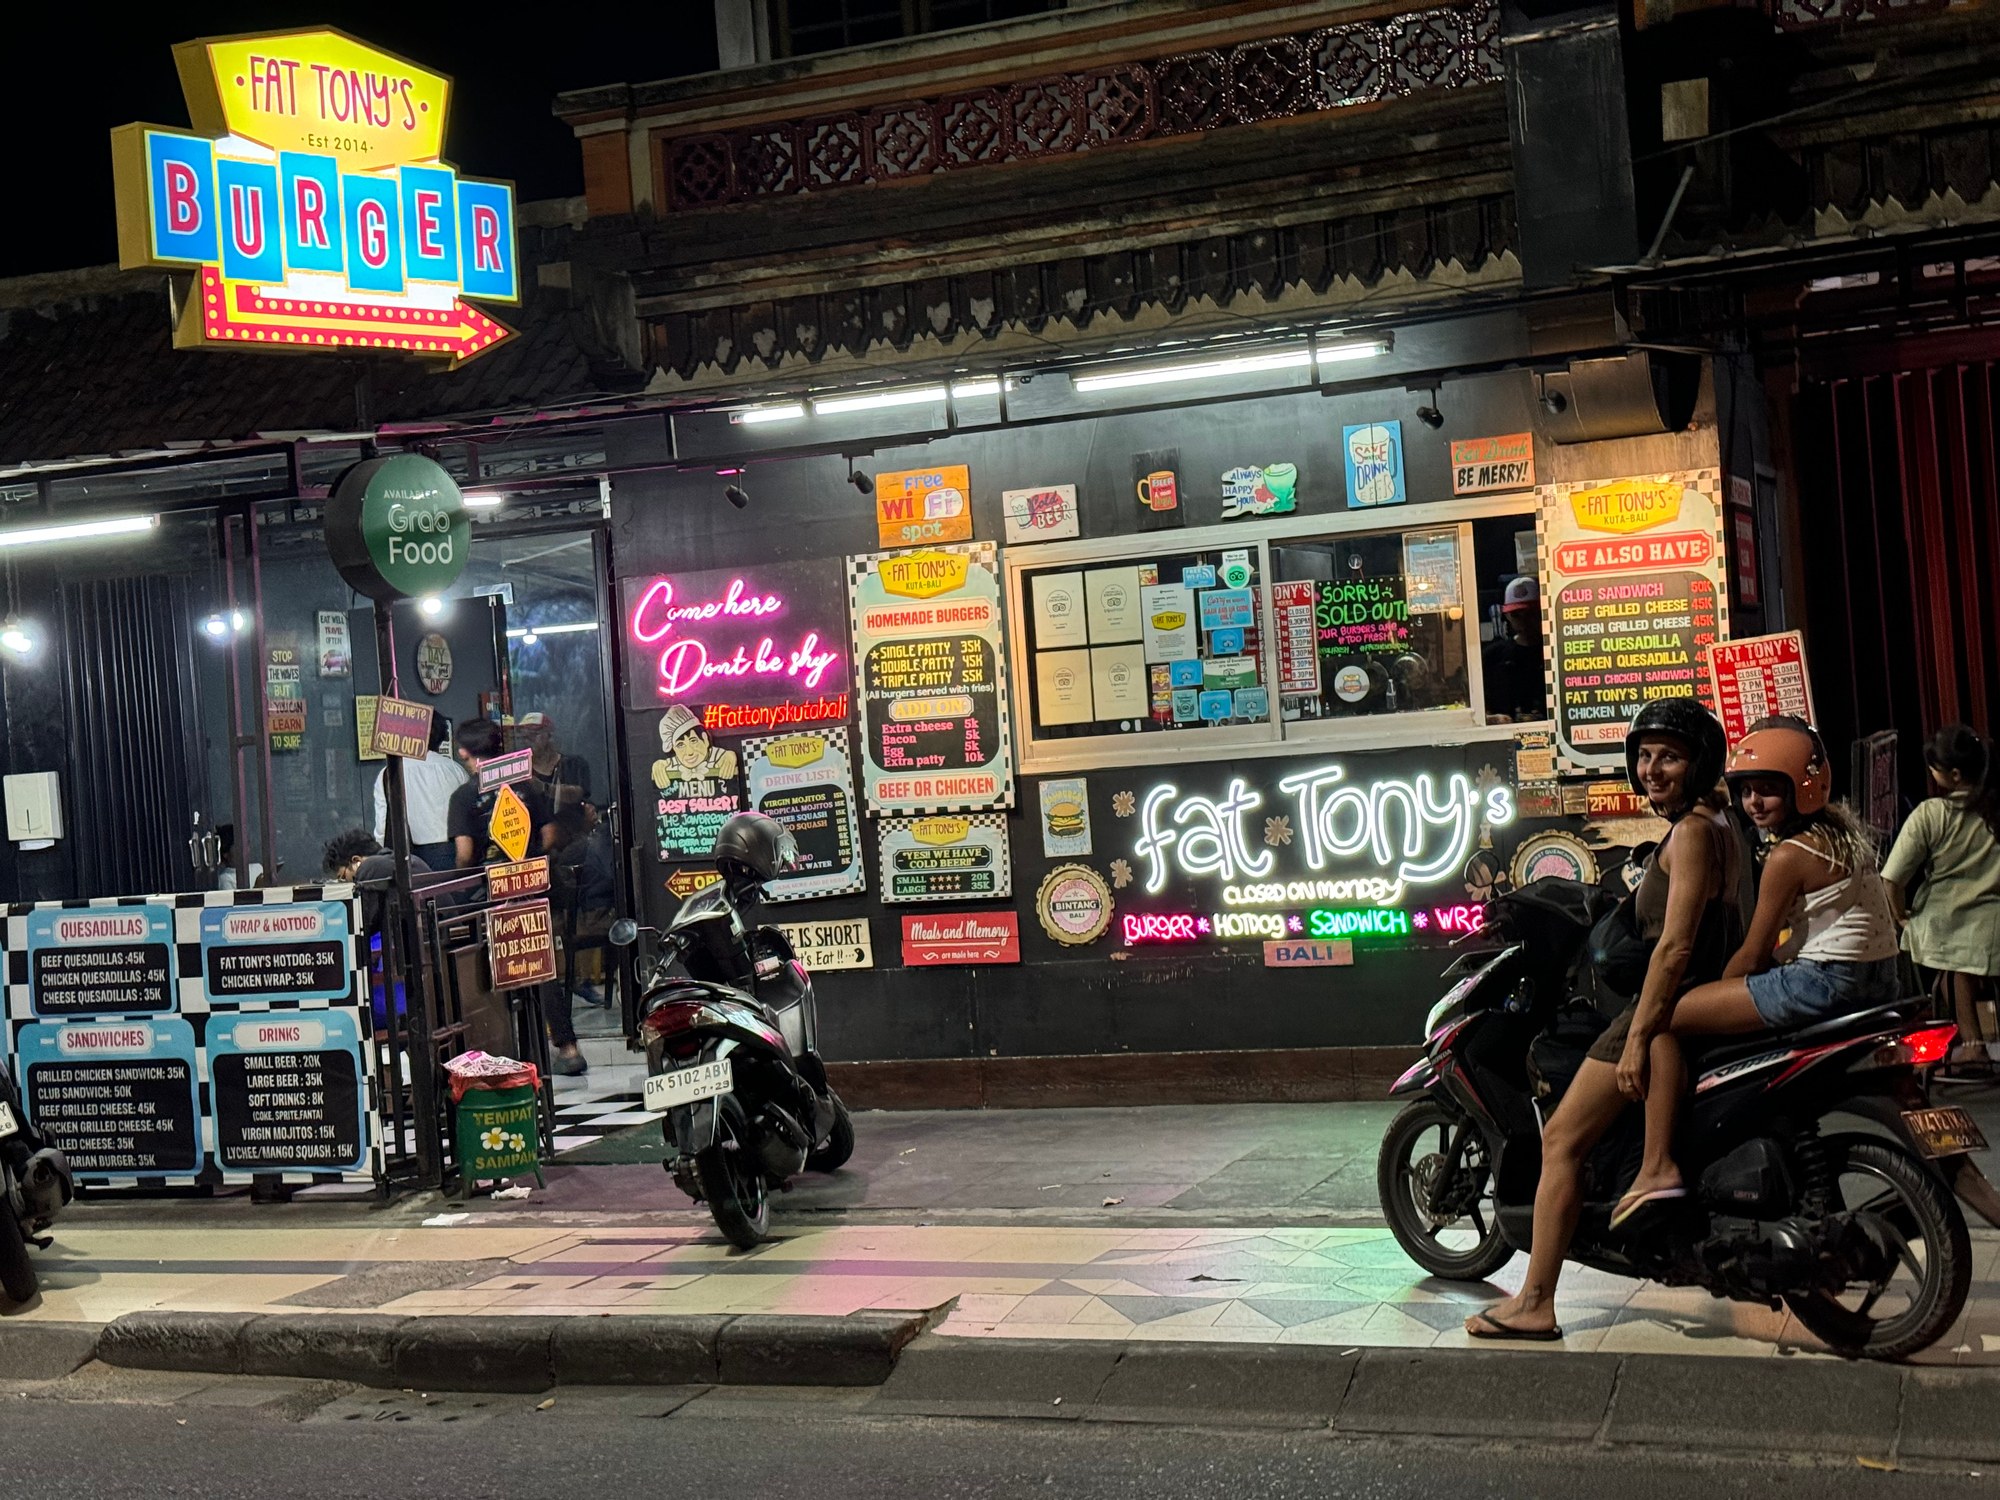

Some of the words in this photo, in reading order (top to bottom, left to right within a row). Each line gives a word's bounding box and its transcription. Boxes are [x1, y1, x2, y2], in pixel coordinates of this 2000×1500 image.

[250, 56, 300, 115] FAT
[310, 64, 416, 130] TONY'S
[308, 133, 328, 148] Est
[334, 137, 368, 153] 2014
[163, 159, 504, 273] BURGER
[1354, 443, 1387, 464] SAVE
[904, 474, 943, 490] Free
[1152, 478, 1173, 486] BEER
[1356, 462, 1388, 490] DRINK
[1457, 467, 1474, 488] BE
[1478, 461, 1528, 487] MERRY!
[1225, 485, 1254, 494] HAPPY
[1588, 495, 1611, 515] FAT
[1615, 490, 1667, 512] TONY'S
[388, 504, 450, 533] Grab
[1036, 502, 1073, 529] BEER
[1603, 514, 1649, 525] KUTA-BALI
[901, 520, 944, 541] spot
[388, 535, 453, 565] Food
[1561, 550, 1587, 568] WE
[1594, 545, 1643, 566] ALSO
[1649, 539, 1708, 561] HAVE:
[892, 564, 911, 581] FAT
[914, 560, 956, 580] TONY'S
[906, 580, 941, 590] KUTA-BALI
[1322, 584, 1380, 604] SORRY
[1562, 588, 1593, 603] CLUB
[1598, 583, 1664, 600] SANDWICH
[1691, 580, 1712, 593] 50K
[634, 581, 723, 642] Come
[723, 579, 781, 615] here
[867, 610, 933, 629] HOMEMADE
[936, 605, 989, 623] BURGERS
[1316, 603, 1367, 628] SOLD
[1372, 600, 1408, 621] OUT!
[273, 650, 293, 662] STOP
[880, 645, 916, 659] SINGLE
[918, 642, 951, 656] PATTY
[961, 640, 981, 653] 35K
[1716, 645, 1744, 664] FAT
[1744, 637, 1798, 660] TONY'S
[659, 640, 751, 696] Dont
[755, 637, 783, 673] be
[788, 633, 837, 688] shy
[1738, 670, 1762, 679] CLOSED
[1773, 664, 1798, 674] CLOSED
[269, 668, 281, 680] THE
[280, 668, 299, 680] WAVES
[275, 685, 290, 696] BUT
[865, 691, 880, 701] (All
[881, 689, 915, 701] burgers
[917, 686, 947, 696] served
[949, 684, 969, 694] with
[971, 682, 994, 693] fries)
[273, 719, 302, 730] LEARN
[882, 723, 912, 734] Extra
[914, 721, 953, 732] cheese
[964, 718, 979, 729] 5k
[272, 736, 282, 748] TO
[284, 735, 302, 748] SURF
[774, 743, 787, 758] FAT
[788, 741, 818, 755] TONY'S
[765, 774, 803, 787] DRINK
[806, 770, 835, 782] LIST:
[678, 779, 716, 798] MENU
[879, 782, 910, 799] BEEF
[914, 780, 932, 796] OR
[936, 777, 994, 795] CHICKEN
[764, 798, 790, 808] VIRGIN
[792, 794, 826, 804] MOJITOS
[502, 807, 517, 817] LEADS
[501, 832, 510, 841] FAT
[919, 823, 934, 836] FAT
[935, 821, 960, 835] TONY'S
[1135, 779, 1273, 893] fat
[1279, 765, 1512, 883] Tony's
[491, 878, 508, 895] 2PM
[511, 876, 522, 890] TO
[896, 876, 927, 884] SMALL
[971, 873, 989, 881] 20K
[1056, 901, 1097, 911] BINTANG
[61, 918, 143, 942] QUESADILLAS
[230, 919, 260, 934] WRAP
[263, 922, 270, 932] &
[273, 916, 316, 932] HOTDOG
[494, 916, 519, 938] Please
[519, 911, 547, 933] WAIT
[911, 920, 941, 941] Meals
[943, 922, 963, 939] and
[965, 919, 1010, 946] Memory
[799, 927, 812, 948] IS
[816, 923, 862, 948] SHORT
[494, 942, 507, 960] TO
[508, 939, 519, 955] BE
[520, 934, 549, 954] SEATED
[942, 951, 951, 959] are
[951, 950, 966, 959] made
[967, 950, 979, 959] here
[1276, 946, 1333, 962] BALI
[220, 956, 237, 970] FAT
[239, 954, 271, 969] TONY'S
[273, 953, 315, 967] HOTDOG:
[316, 952, 335, 965] 35K
[816, 951, 835, 966] Eat
[507, 960, 527, 977] Thank
[41, 972, 80, 986] CHICKEN
[82, 970, 141, 987] QUESADILLAS
[147, 969, 165, 982] 45K
[67, 1030, 144, 1048] SANDWICHES
[259, 1027, 300, 1042] DRINKS
[244, 1056, 274, 1070] SMALL
[275, 1055, 298, 1069] BEER
[303, 1054, 321, 1068] 20K
[37, 1069, 73, 1083] GRILLED
[74, 1068, 113, 1081] CHICKEN
[115, 1067, 165, 1081] SANDWICH:
[167, 1066, 185, 1079] 35K
[647, 1077, 665, 1096] DK
[667, 1071, 700, 1090] 5102
[704, 1061, 730, 1081] ABV
[473, 1105, 533, 1126] TEMPAT
[242, 1127, 272, 1141] VIRGIN
[273, 1126, 313, 1140] MOJITOS
[319, 1125, 335, 1138] 15K
[227, 1146, 294, 1160] LYCHEE/MANGO
[296, 1145, 331, 1160] SQUASH
[337, 1144, 353, 1158] 15K
[475, 1152, 536, 1170] SAMPAH
